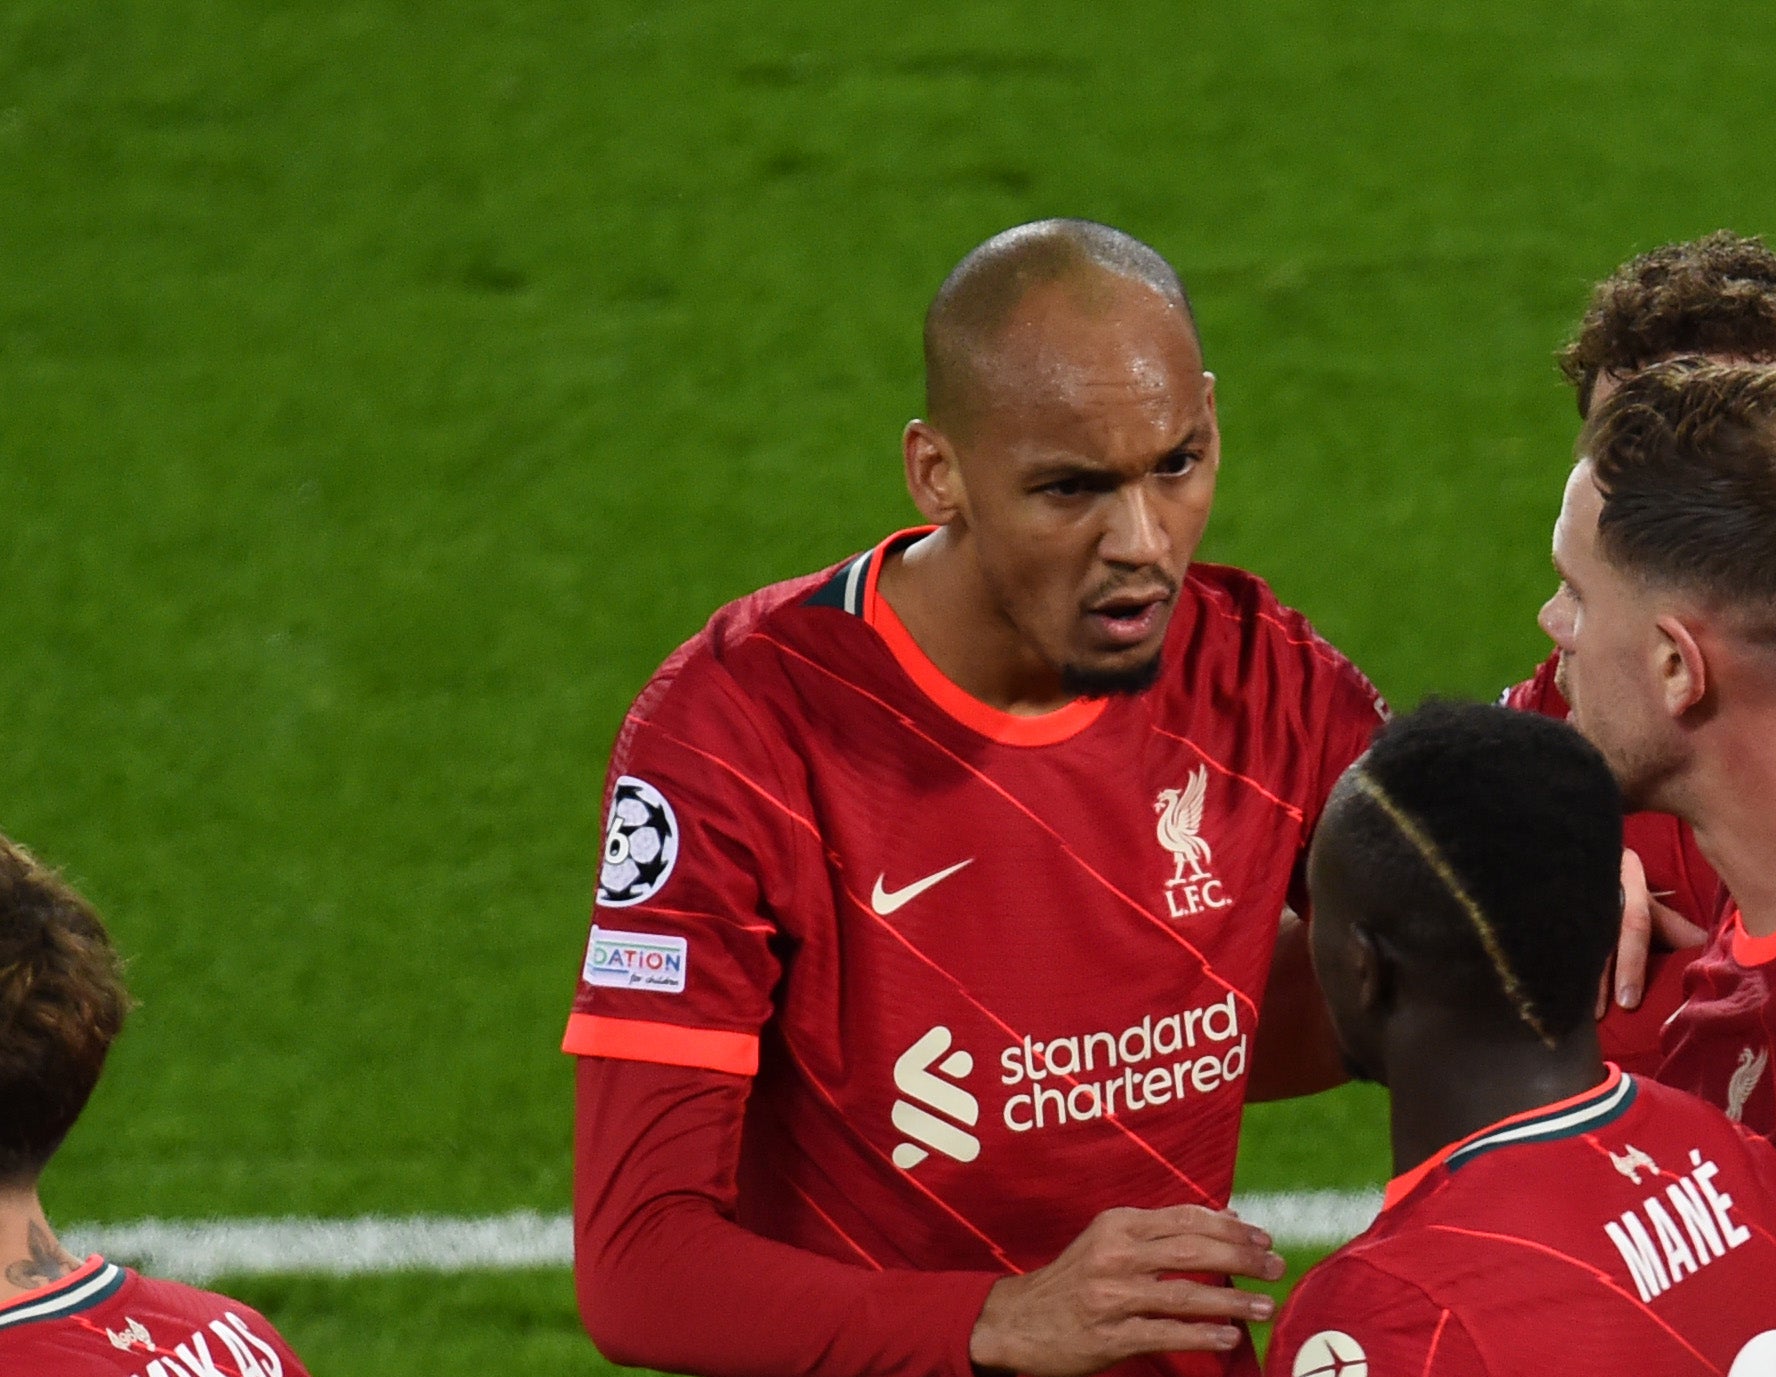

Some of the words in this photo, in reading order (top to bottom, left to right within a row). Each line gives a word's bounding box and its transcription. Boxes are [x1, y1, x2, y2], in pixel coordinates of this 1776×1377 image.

[1001, 991, 1238, 1085] standard
[1003, 1034, 1246, 1132] chartered
[1603, 1149, 1751, 1303] MANÉ
